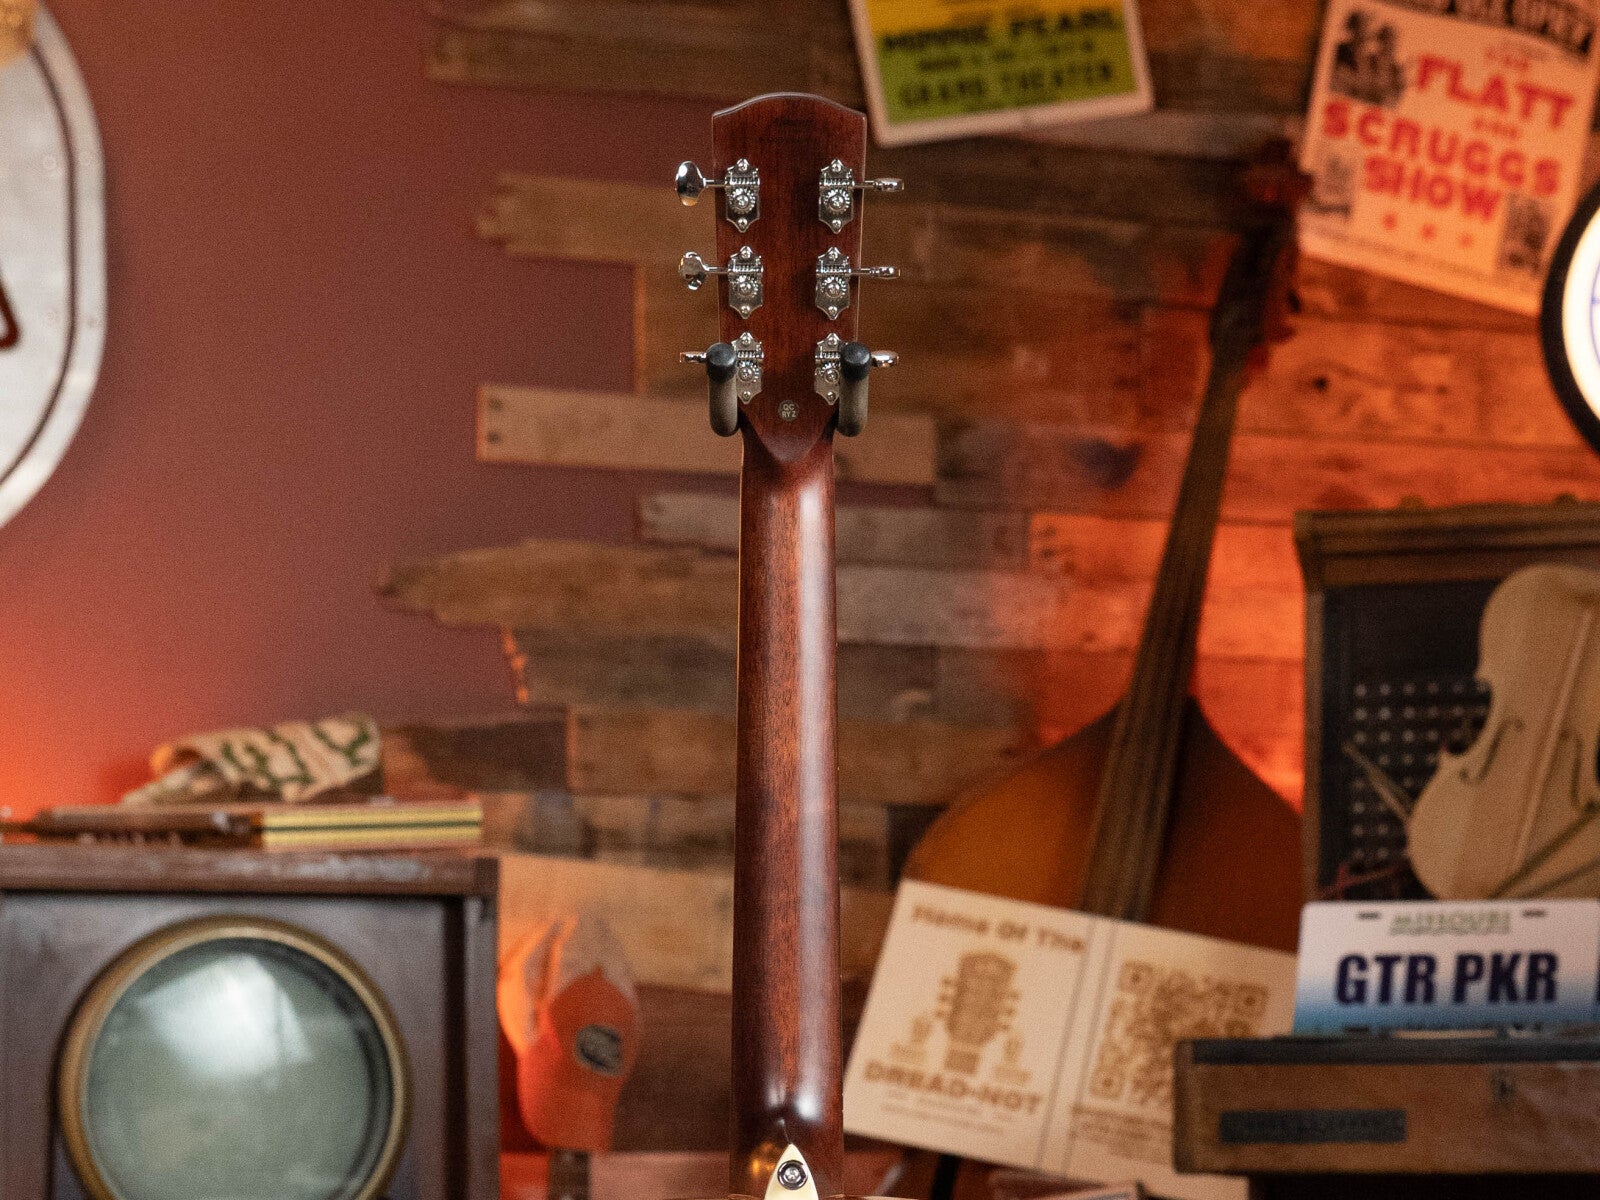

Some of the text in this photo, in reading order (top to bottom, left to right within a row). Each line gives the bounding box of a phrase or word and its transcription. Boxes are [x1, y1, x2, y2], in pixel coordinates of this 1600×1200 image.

[1417, 53, 1576, 129] FLATT
[1323, 98, 1560, 197] SCRUGGS
[1364, 155, 1502, 223] SHOW
[997, 918, 1029, 943] Of
[1038, 927, 1089, 955] The
[1335, 953, 1438, 1006] GTR
[1453, 952, 1559, 1005] PKR
[864, 1059, 1043, 1114] DREAD-NOT
